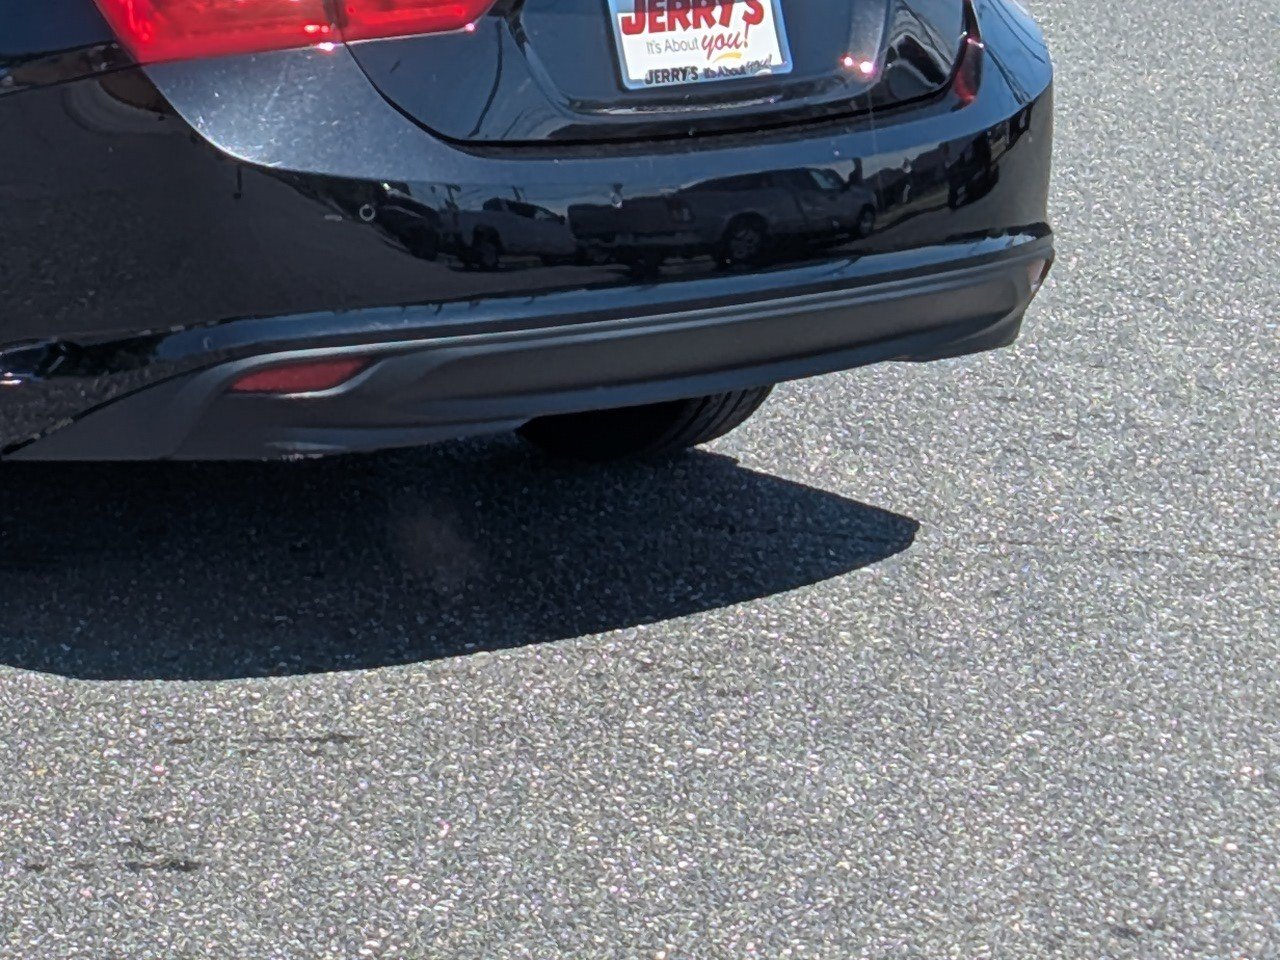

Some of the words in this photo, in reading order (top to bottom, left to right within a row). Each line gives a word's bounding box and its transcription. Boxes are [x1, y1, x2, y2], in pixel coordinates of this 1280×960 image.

[647, 40, 662, 54] It's
[664, 37, 699, 53] About
[701, 22, 748, 60] you!
[644, 66, 699, 85] JERRY'S
